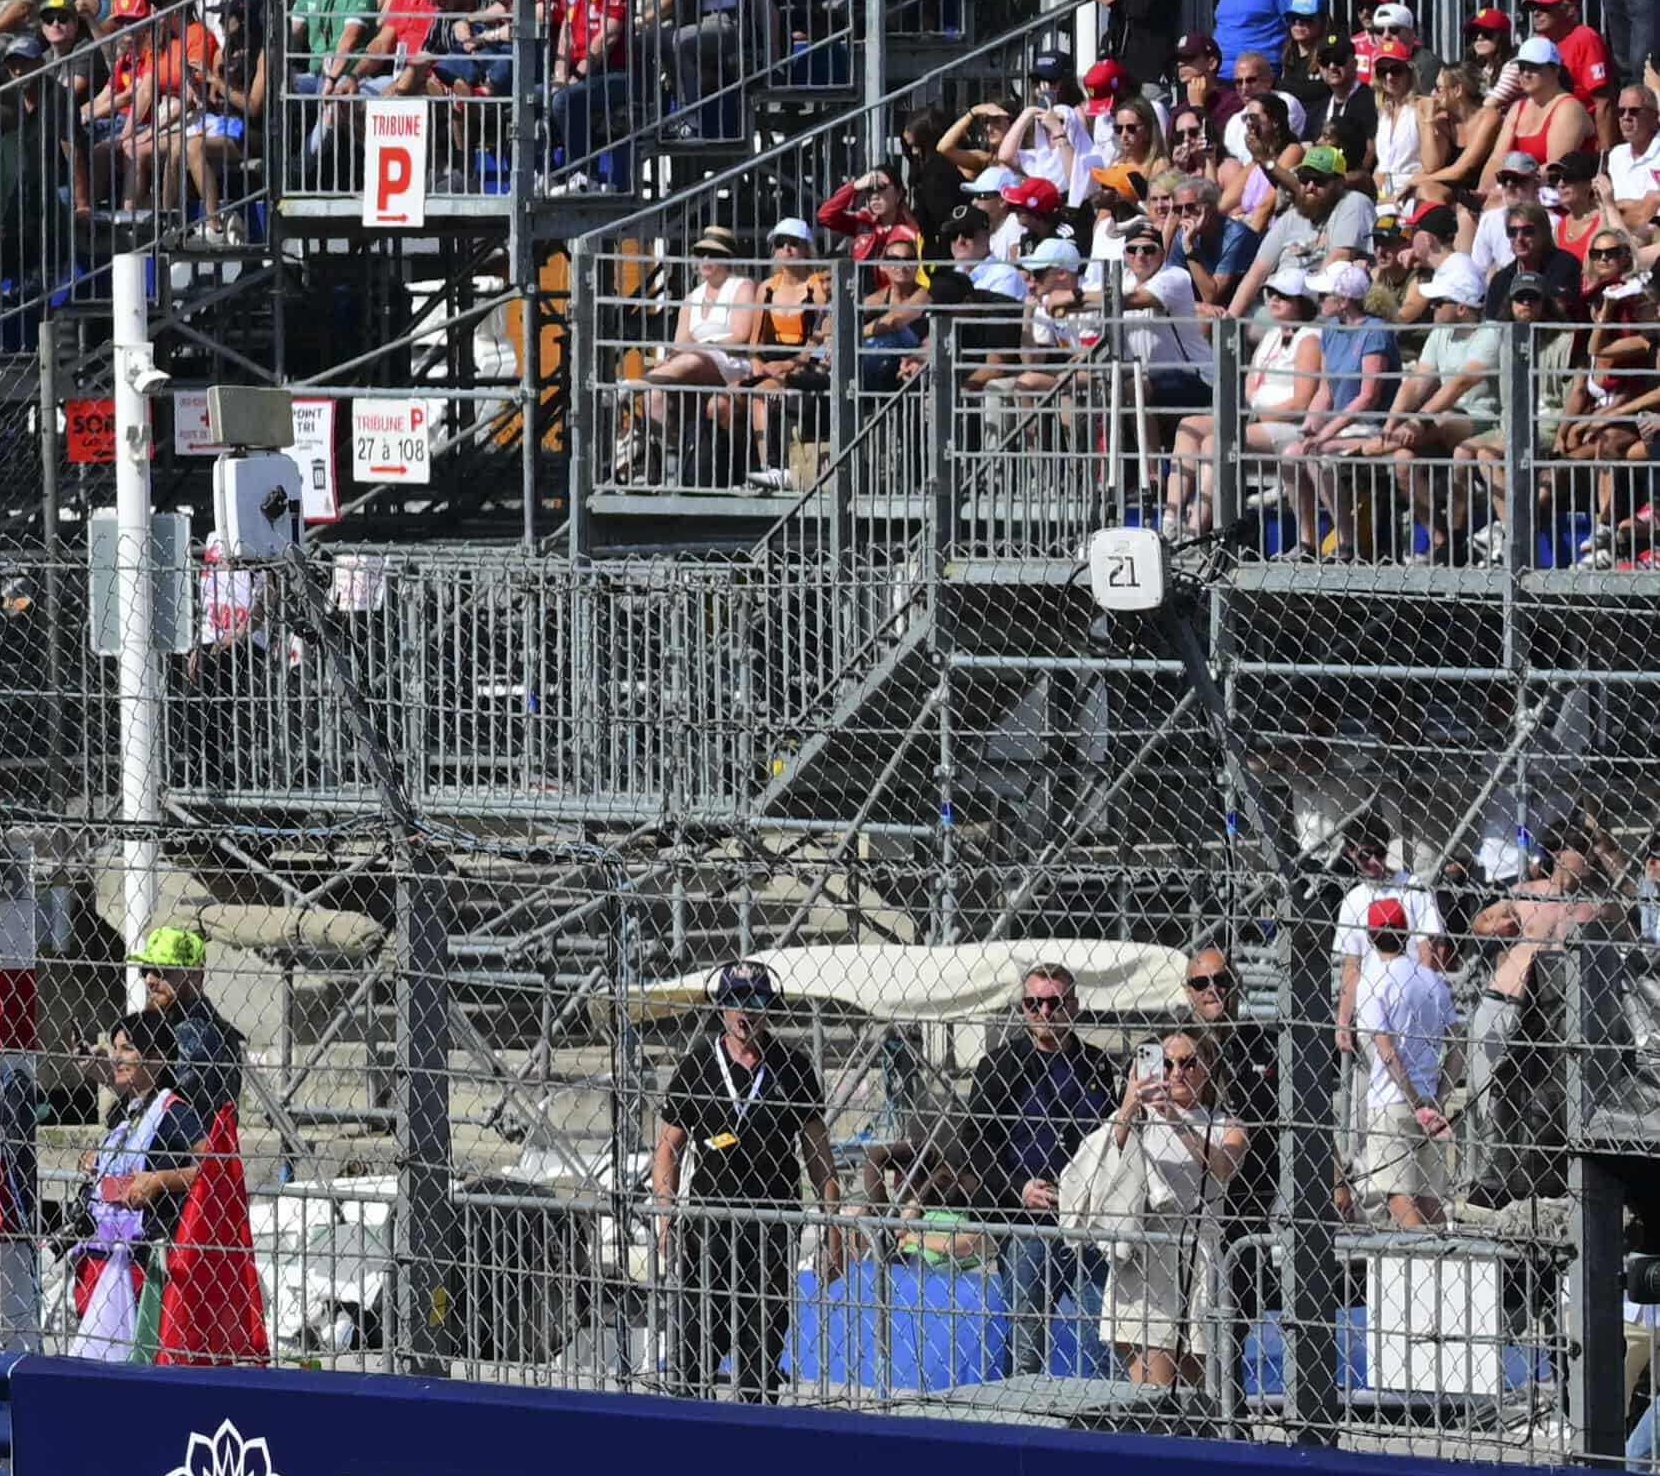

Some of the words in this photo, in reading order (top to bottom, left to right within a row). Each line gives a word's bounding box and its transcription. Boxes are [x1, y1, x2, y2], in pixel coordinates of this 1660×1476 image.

[372, 115, 421, 136] TRIBUNE
[377, 146, 412, 211] P
[294, 407, 324, 422] OINT
[356, 416, 406, 432] TRIBUNE
[410, 407, 425, 432] P
[296, 421, 316, 434] TRI
[357, 437, 375, 461] 27
[397, 437, 425, 462] 108
[1108, 556, 1141, 588] 21
